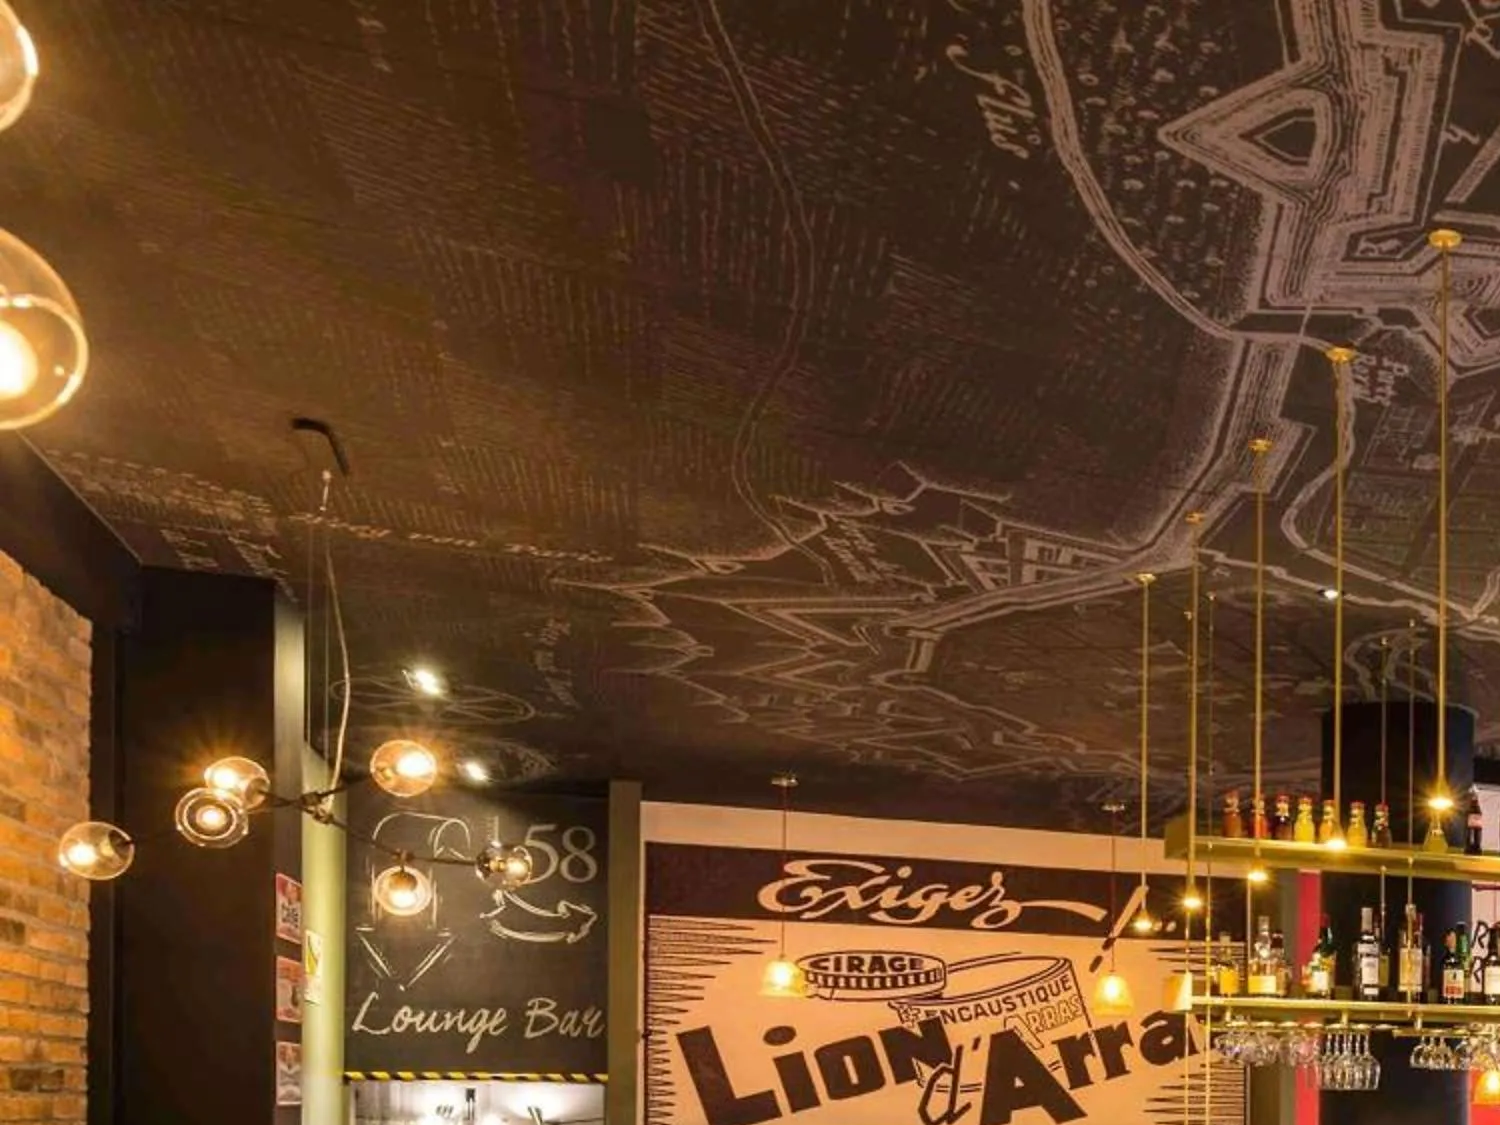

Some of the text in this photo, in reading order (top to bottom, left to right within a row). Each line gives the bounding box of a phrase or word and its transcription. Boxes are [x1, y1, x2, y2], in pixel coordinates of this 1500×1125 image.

[757, 859, 1108, 929] Exigez
[808, 954, 924, 974] CIRAGE
[352, 992, 607, 1054] Lounge Bar
